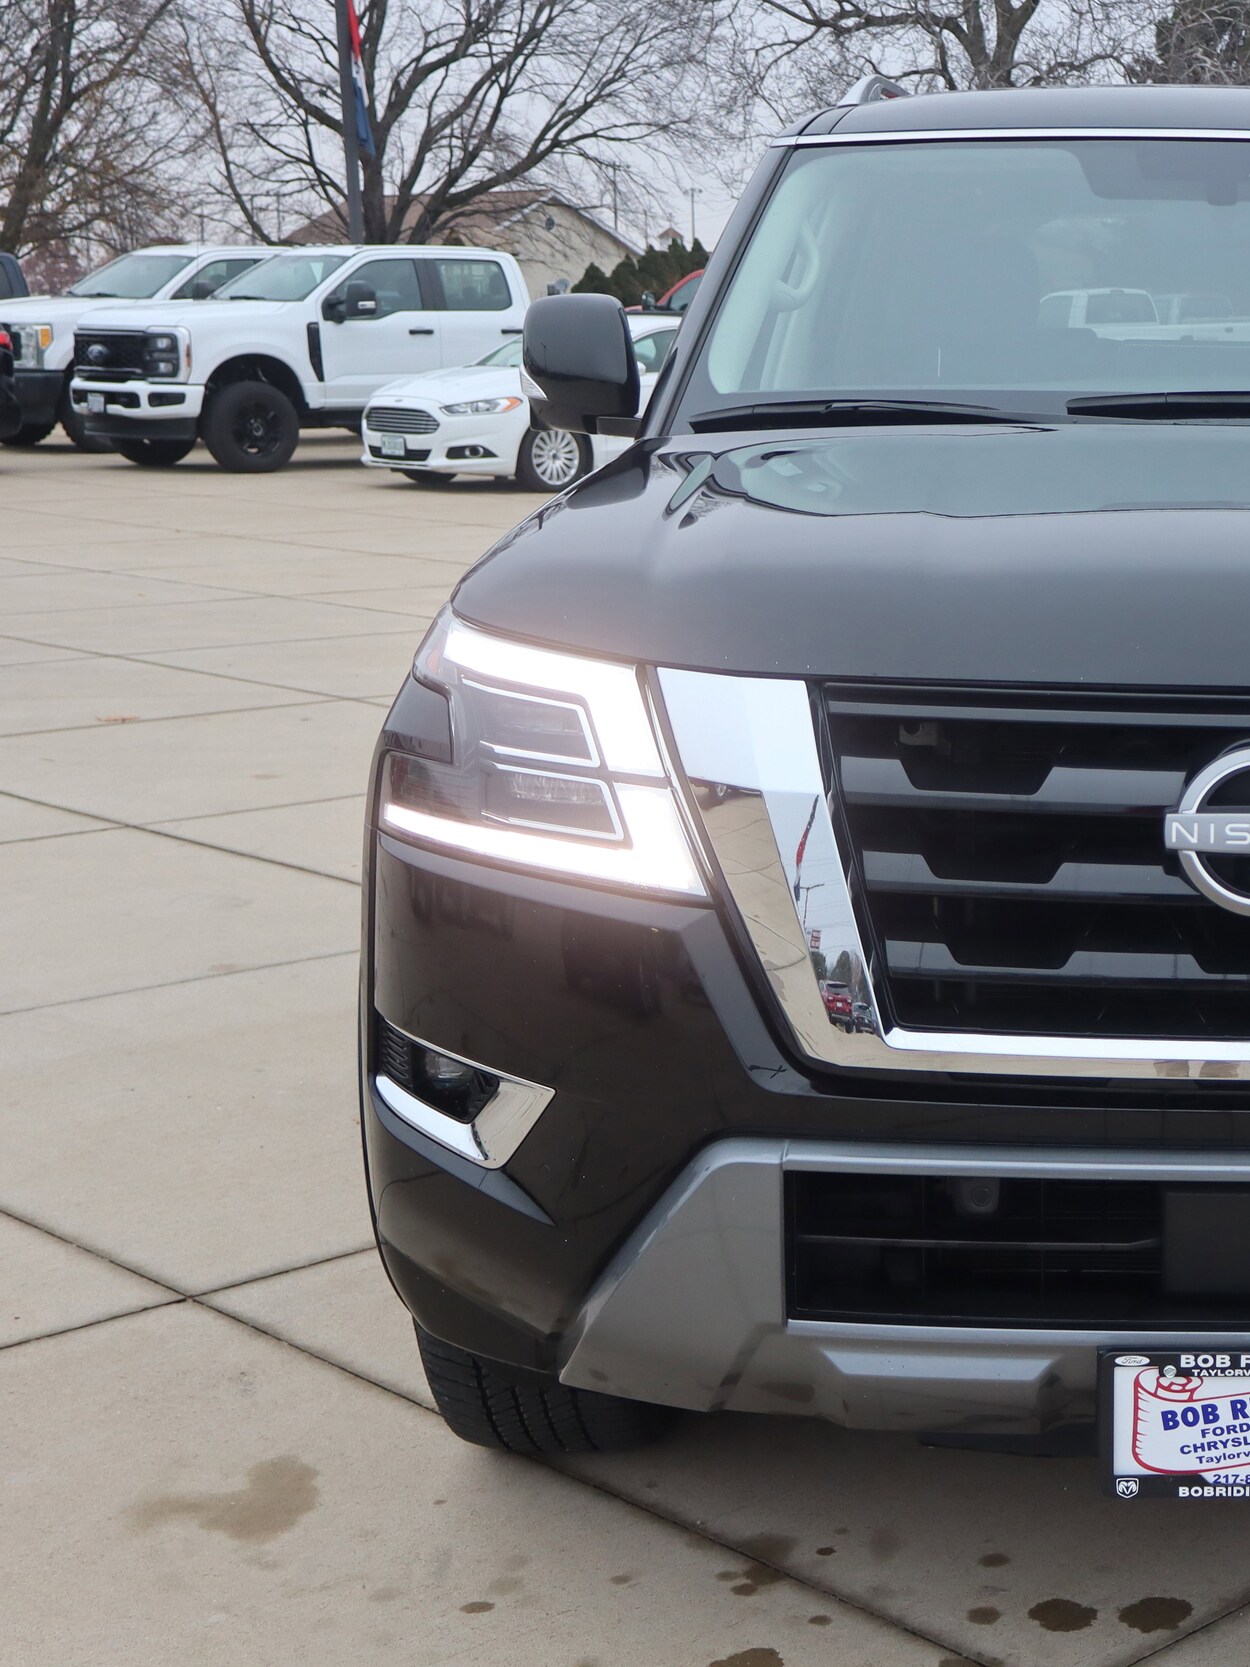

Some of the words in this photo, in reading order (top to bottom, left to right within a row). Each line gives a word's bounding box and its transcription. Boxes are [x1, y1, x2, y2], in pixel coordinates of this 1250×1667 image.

[1180, 1354, 1232, 1368] BOB
[1160, 1403, 1220, 1431] BOB
[1200, 1422, 1250, 1439] FORD
